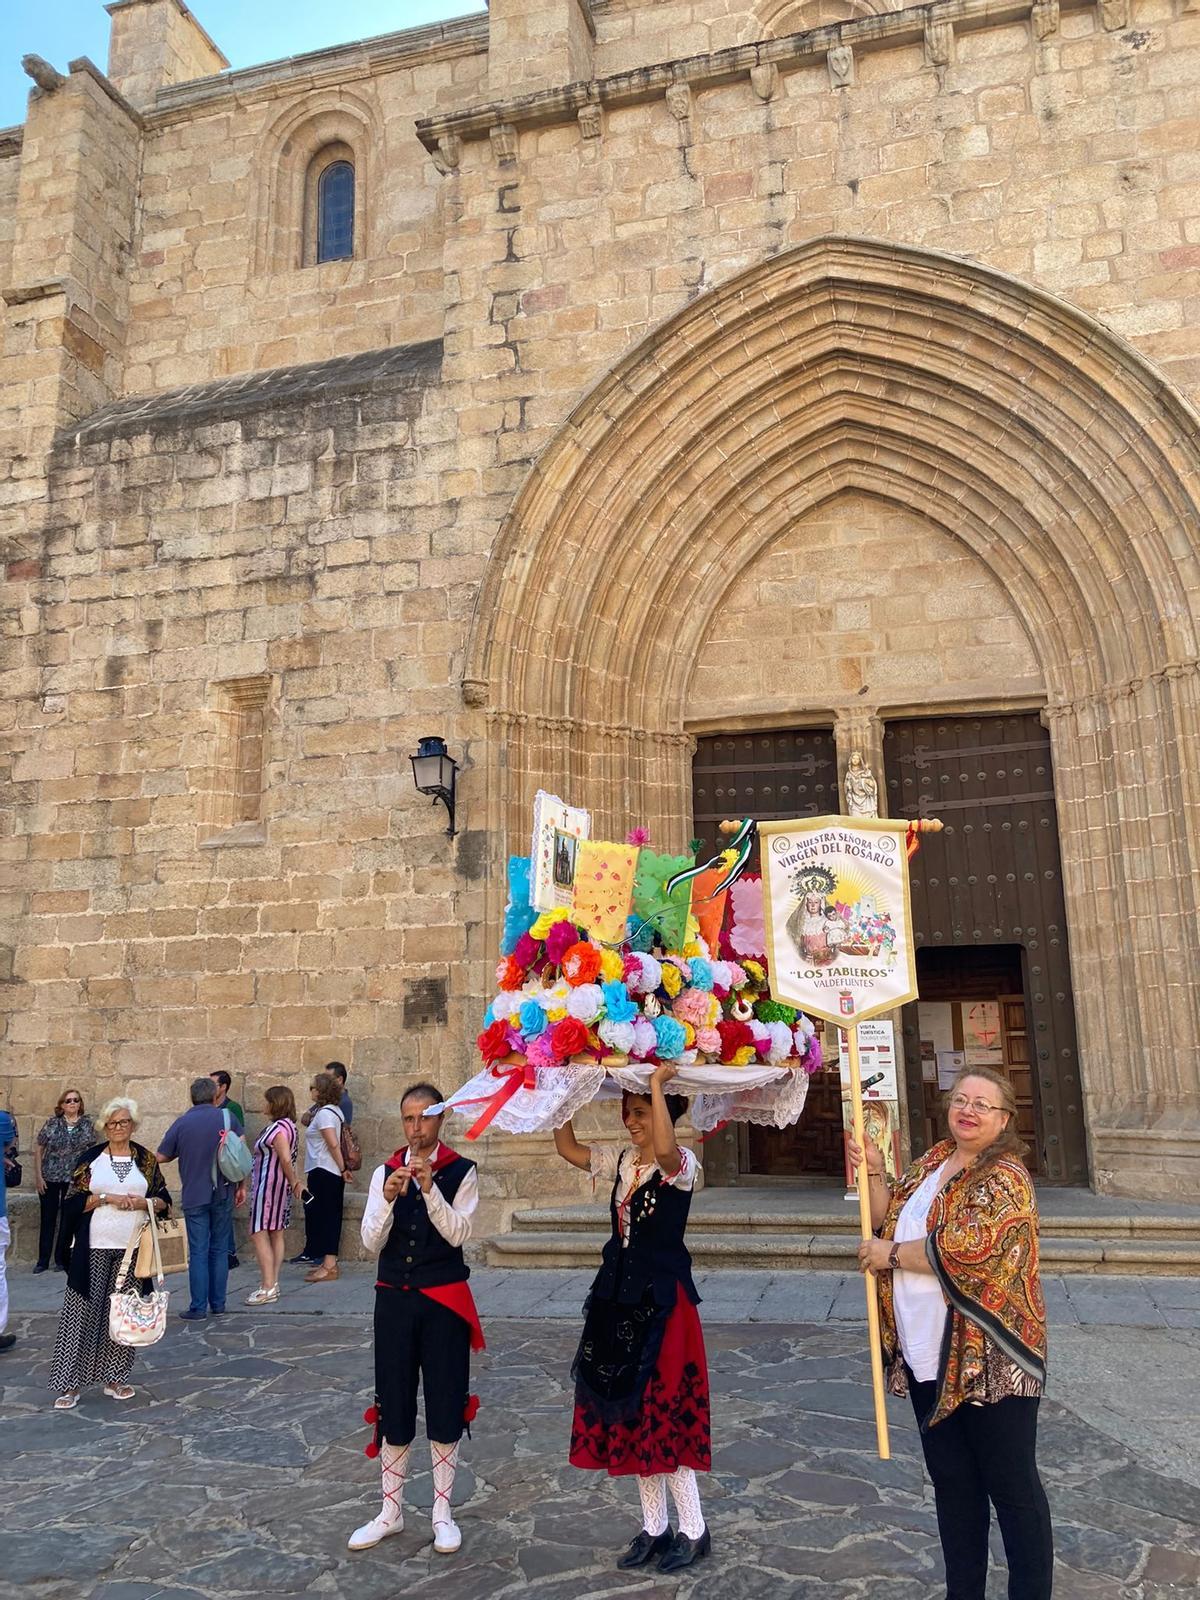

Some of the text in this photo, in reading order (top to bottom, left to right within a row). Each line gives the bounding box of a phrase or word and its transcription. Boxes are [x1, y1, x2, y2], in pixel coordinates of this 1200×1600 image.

[796, 832, 872, 850] NUESTRA SEÑORA
[778, 842, 894, 868] VIRGEN DEL ROSARIO
[813, 978, 874, 988] VALDEFUENTES
